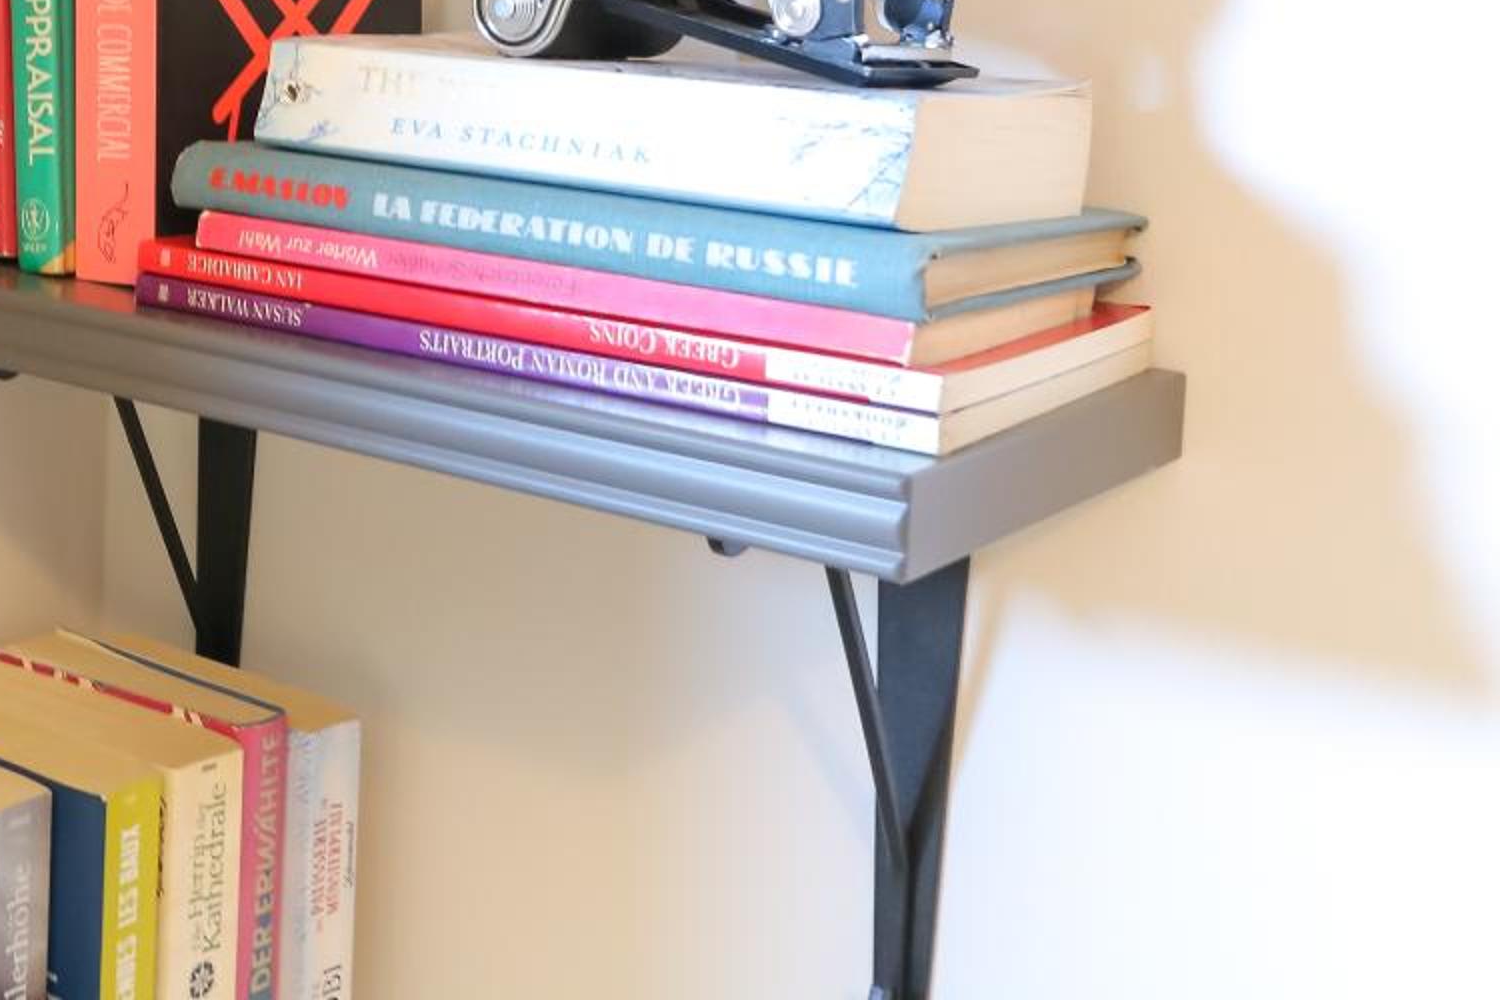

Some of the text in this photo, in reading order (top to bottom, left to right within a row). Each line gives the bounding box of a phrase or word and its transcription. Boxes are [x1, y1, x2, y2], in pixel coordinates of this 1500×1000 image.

[96, 21, 133, 162] COMMERCIAL
[390, 116, 653, 164] EVA STACHNIAK
[237, 228, 283, 253] Wahl
[286, 233, 313, 253] zur
[314, 238, 379, 269] Wörter
[372, 191, 860, 289] LA FEDERATION DE RUSSIE
[186, 286, 302, 327] SUSAN WALKER
[418, 328, 525, 371] PORTRAITS
[589, 319, 741, 368] GREEK COINS
[531, 352, 606, 383] ROMAN
[614, 364, 662, 393] AND
[201, 780, 228, 953] Kathedrale
[4, 862, 31, 1000] lerhöhe
[251, 930, 273, 995] DER
